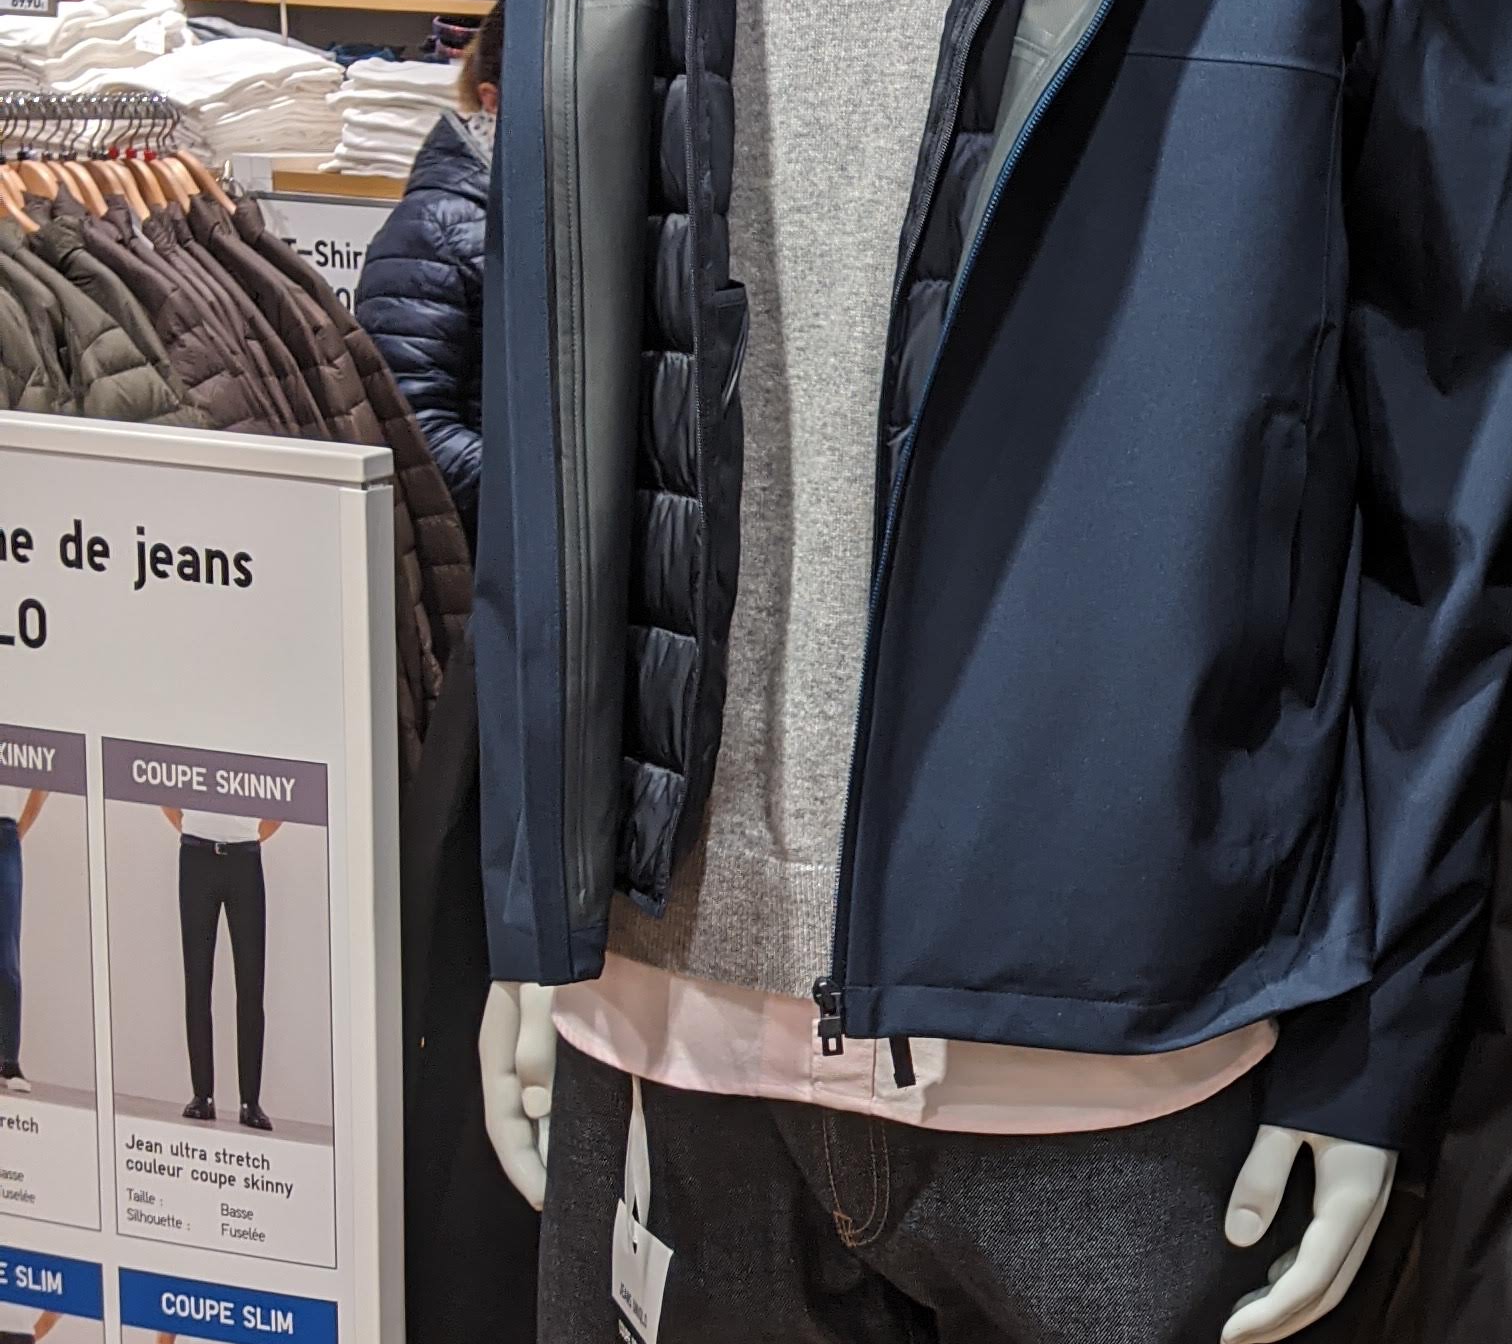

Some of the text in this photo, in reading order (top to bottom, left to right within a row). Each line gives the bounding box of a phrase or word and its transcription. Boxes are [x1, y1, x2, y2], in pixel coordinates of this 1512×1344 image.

[59, 518, 110, 572] de
[134, 525, 253, 591] jeans
[132, 759, 296, 802] COUPE SKINNY
[125, 1134, 270, 1171] Jean ultra stretch
[125, 1158, 294, 1199] couleur coupe skinny
[0, 1185, 36, 1204] uselée
[126, 1188, 156, 1205] Taille
[127, 1209, 183, 1230] Silhouette
[221, 1203, 254, 1221] Basse
[221, 1223, 266, 1243] Fuselée
[15, 1265, 63, 1296] SLIM
[161, 1292, 294, 1335] COUPE SLIM
